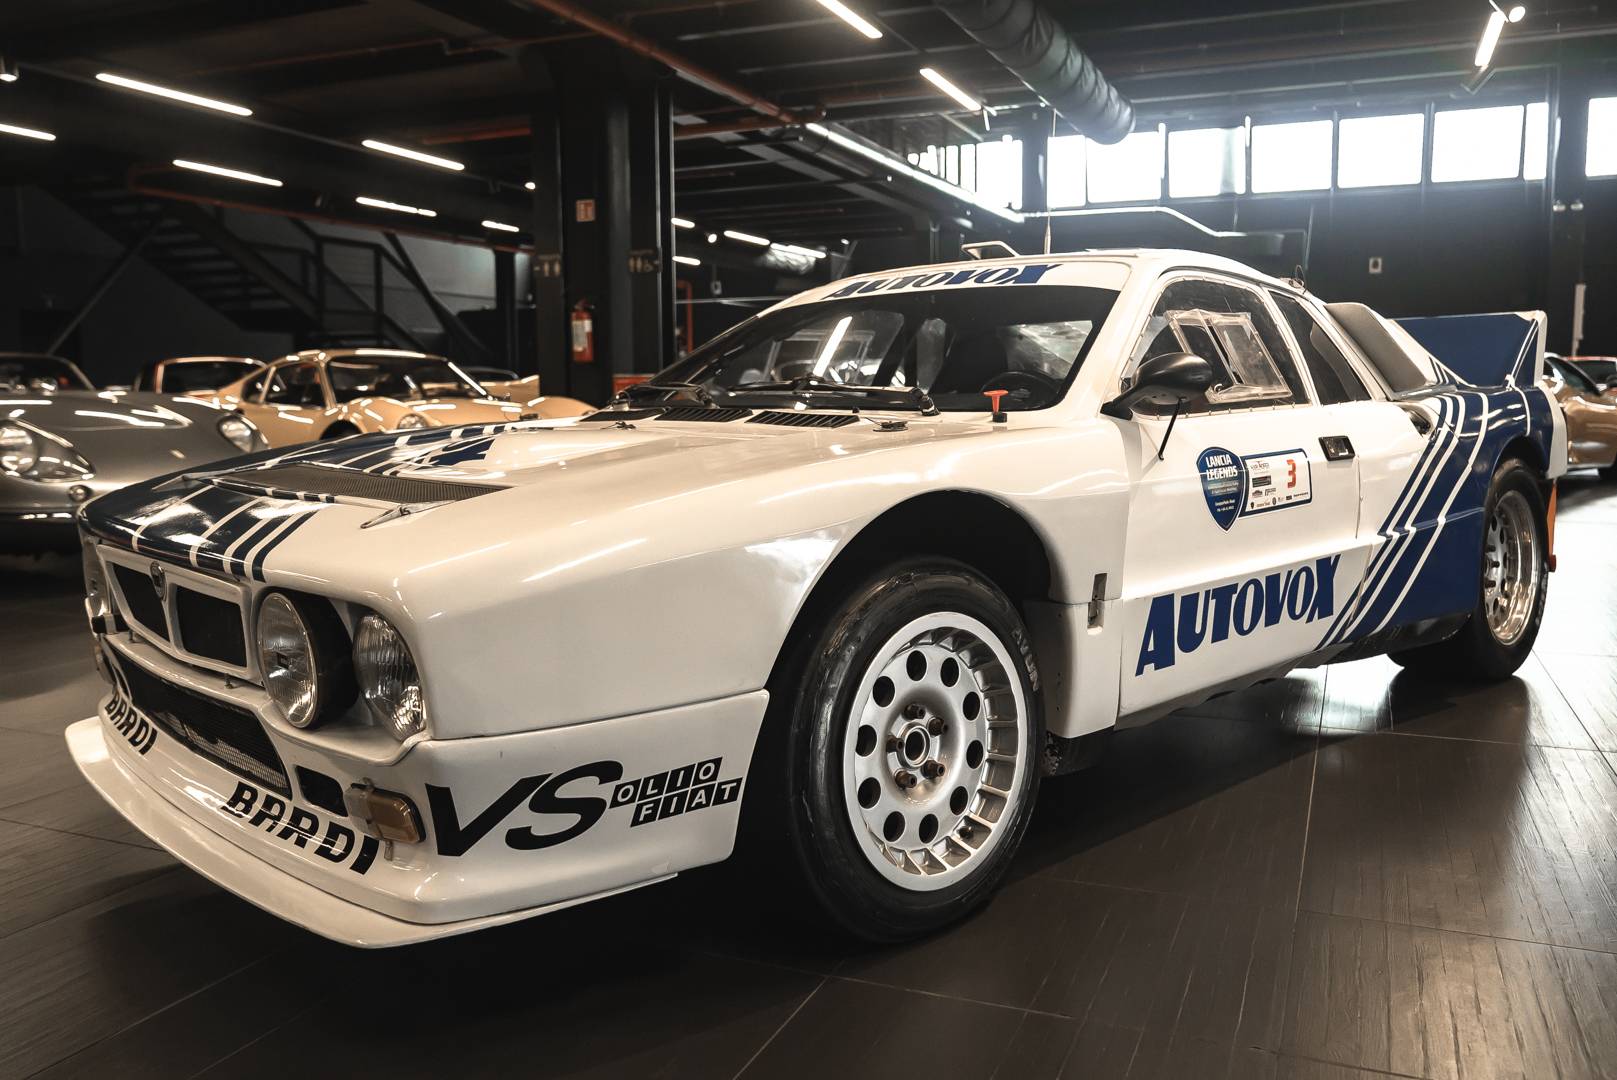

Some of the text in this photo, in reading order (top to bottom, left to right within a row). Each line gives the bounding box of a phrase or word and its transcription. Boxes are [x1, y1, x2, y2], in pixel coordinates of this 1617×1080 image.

[820, 263, 1063, 301] AUTOVOX
[1205, 454, 1233, 468] LANCIA
[1206, 465, 1238, 481] LEGENDS
[1286, 459, 1297, 489] 3
[1135, 553, 1342, 677] AUTOVOX
[104, 692, 158, 756] BARDI
[616, 761, 716, 804] OLIO
[638, 783, 738, 822] FIAT
[220, 780, 380, 876] BARDI
[425, 760, 624, 857] VS
